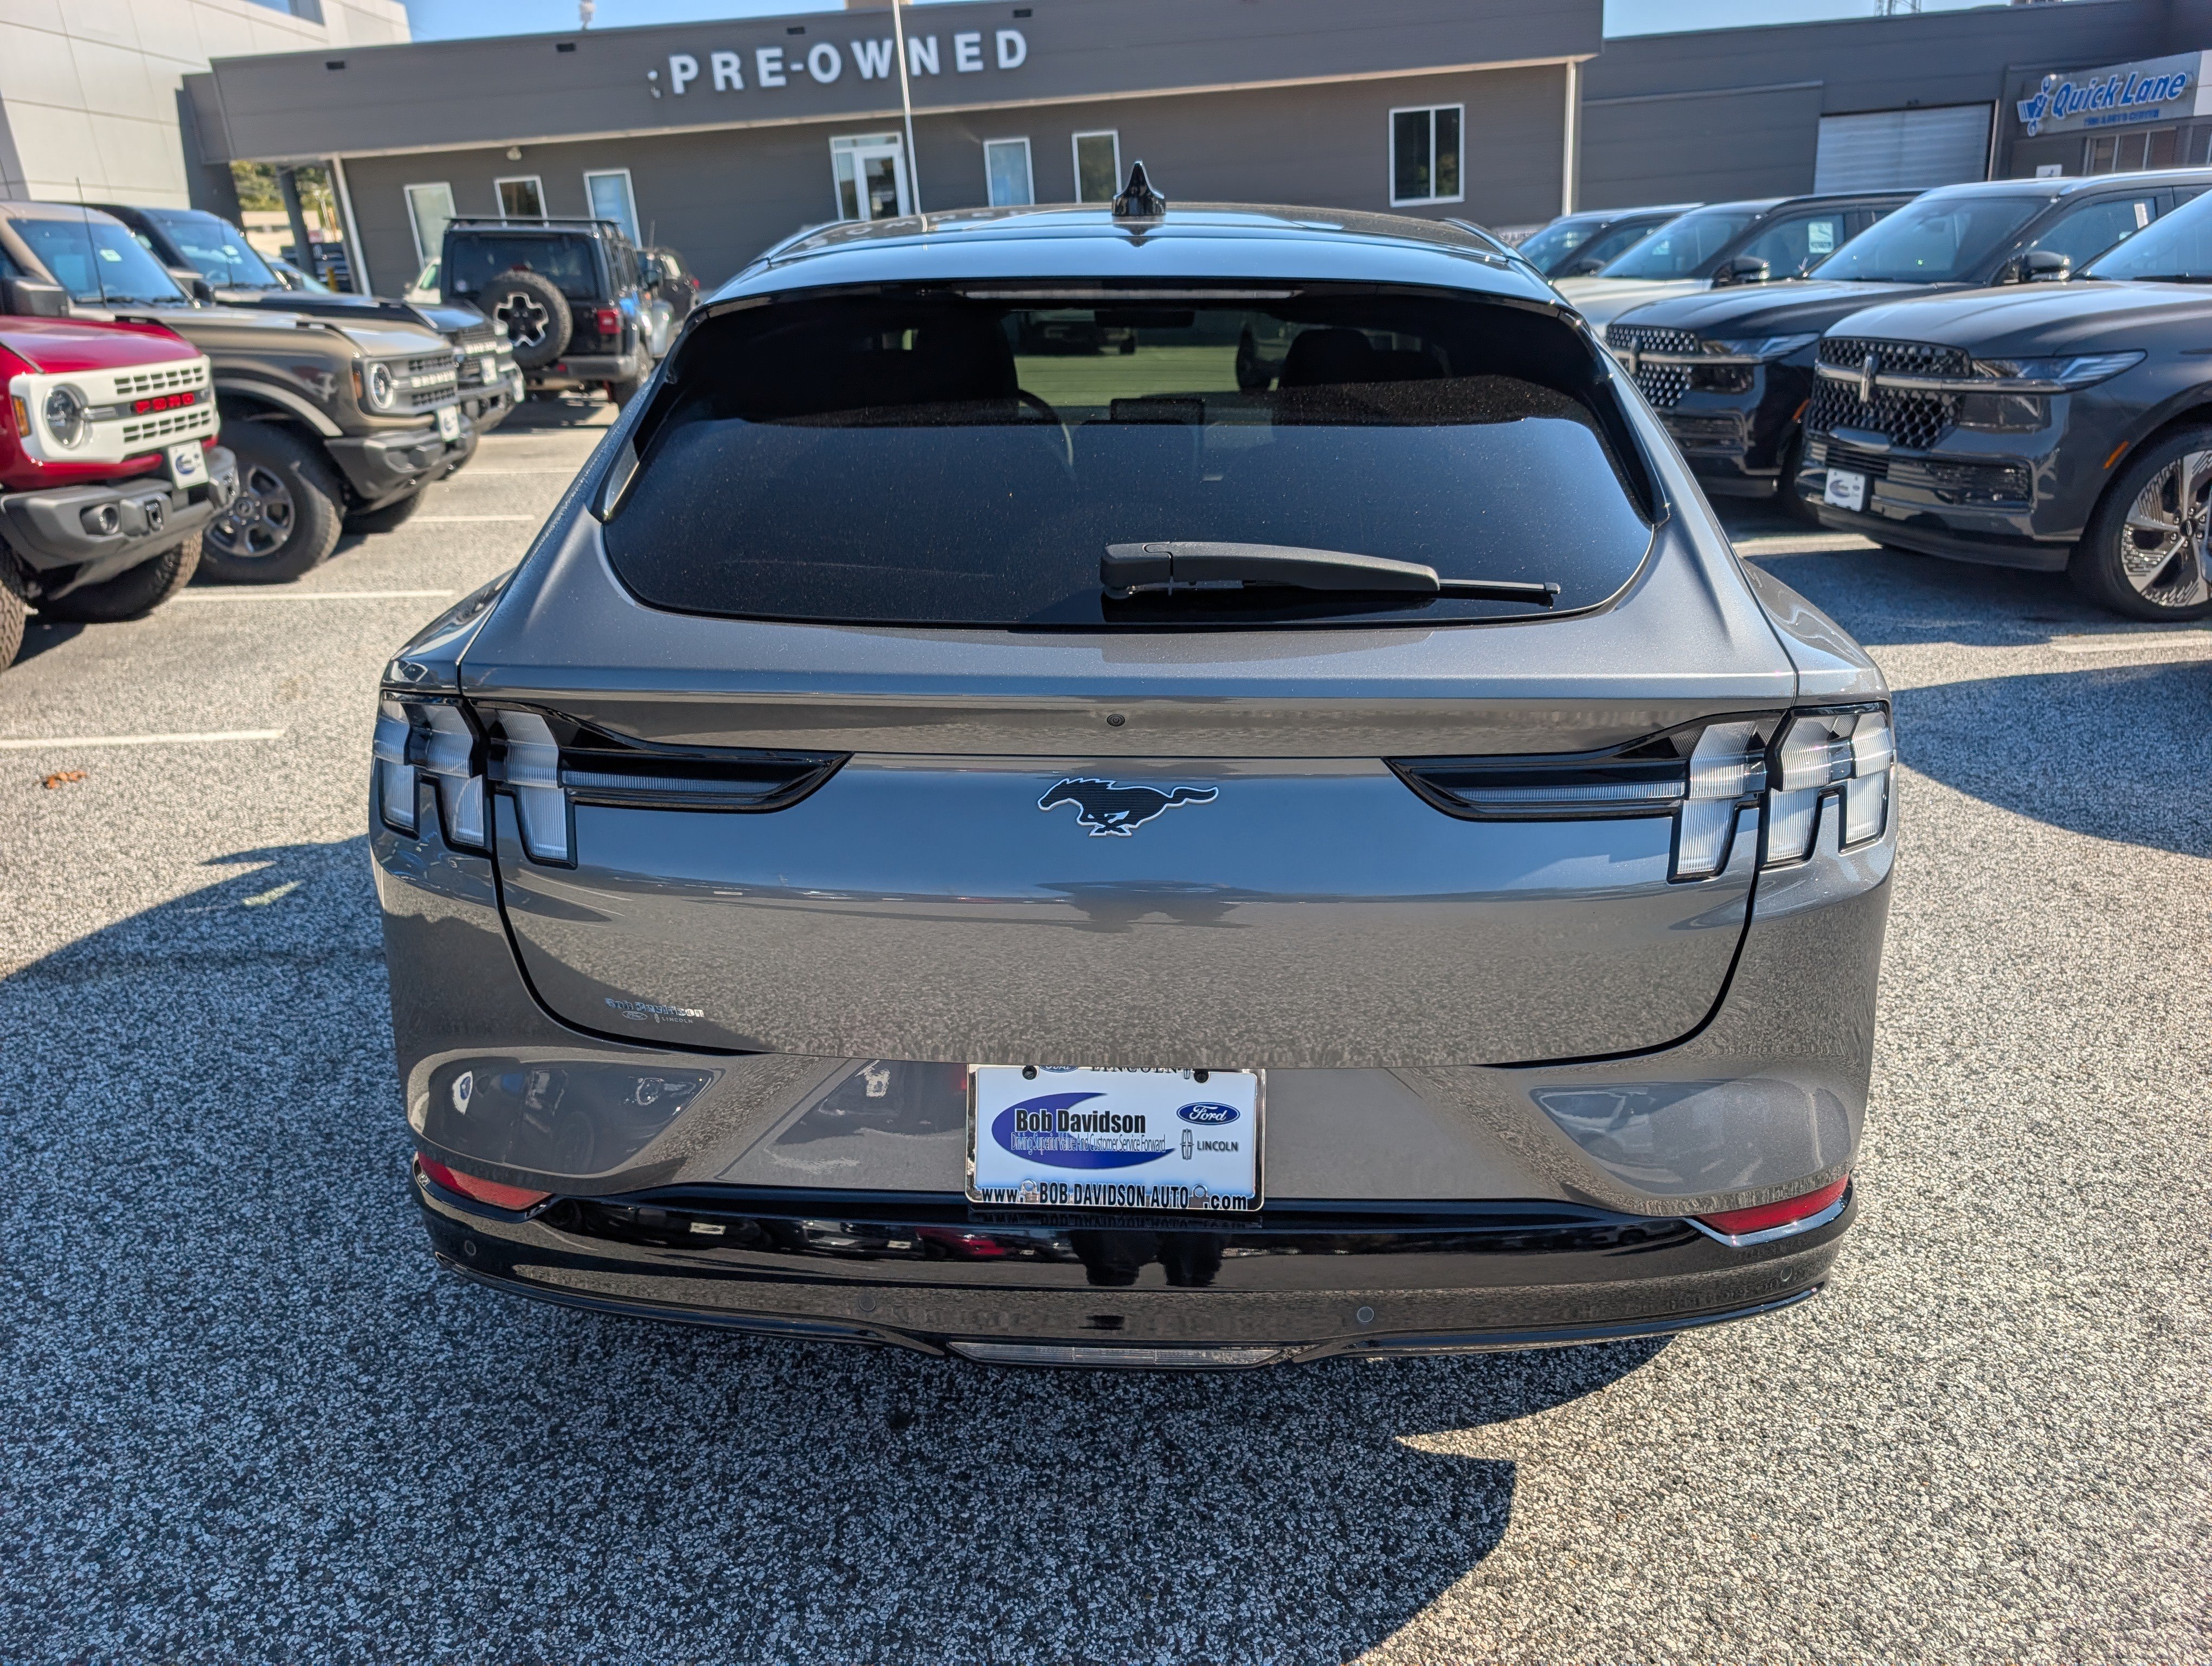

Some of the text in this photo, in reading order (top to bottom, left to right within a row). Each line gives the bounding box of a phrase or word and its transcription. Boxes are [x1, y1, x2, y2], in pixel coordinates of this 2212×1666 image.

[668, 29, 1028, 95] PRE-OWNED
[2051, 75, 2122, 120] Quick
[2118, 71, 2187, 107] Lane
[1015, 1109, 1146, 1133] Bob Davidson
[1189, 1105, 1228, 1121] Ford
[1011, 1132, 1166, 1155] Driving Superior Value And Customer Service Forward
[1197, 1140, 1239, 1151] LINCOLN
[1039, 1182, 1069, 1204] BOB
[1073, 1183, 1146, 1207] DAVIDSON
[1151, 1185, 1189, 1208] AUTO
